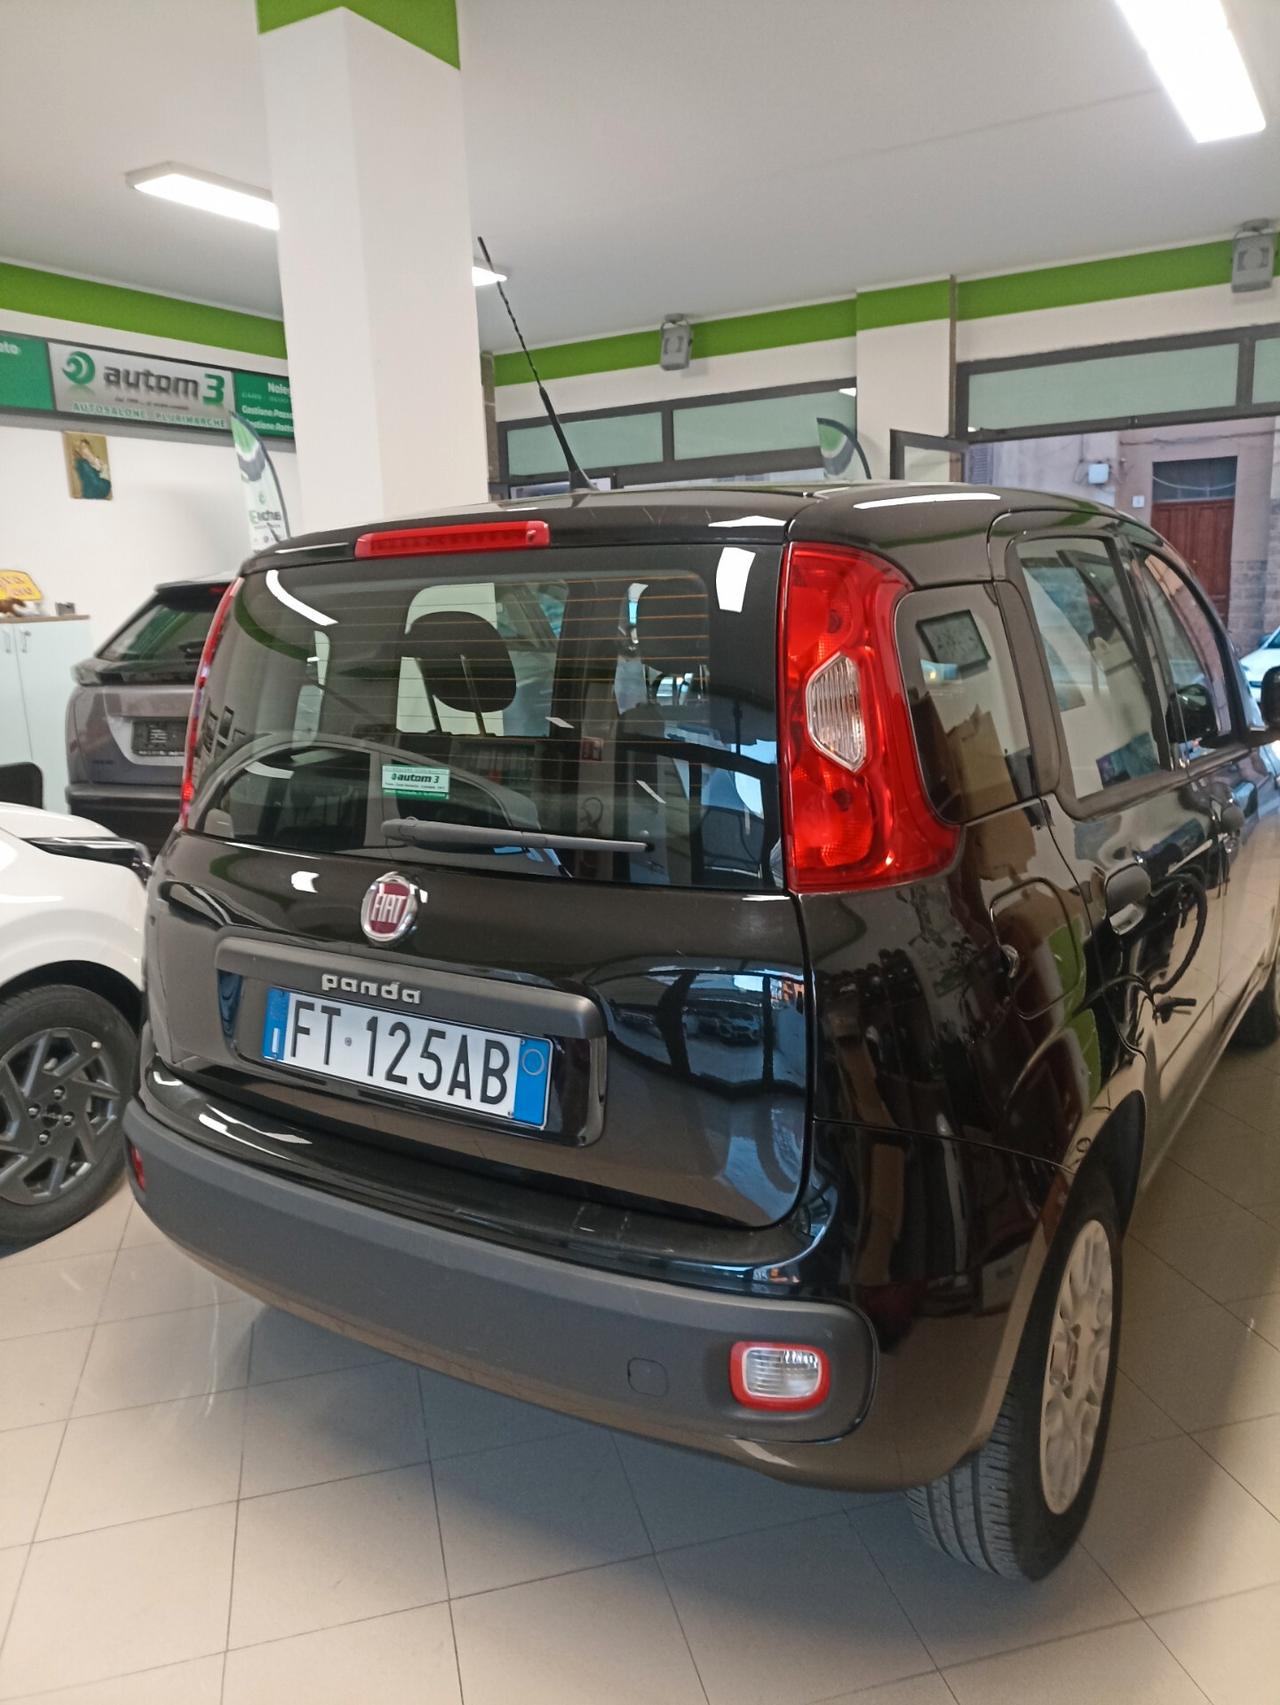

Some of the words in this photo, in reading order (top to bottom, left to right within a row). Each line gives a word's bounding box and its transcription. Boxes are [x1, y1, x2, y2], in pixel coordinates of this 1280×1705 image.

[103, 366, 199, 399] autom
[203, 373, 225, 404] 3
[72, 402, 145, 418] AUTOSALONE
[156, 412, 225, 428] PLURIMARCHE
[397, 774, 432, 783] autom
[370, 893, 407, 924] FIAT
[321, 973, 421, 1004] panda
[291, 999, 341, 1066] FT
[364, 1014, 511, 1105] 125AB
